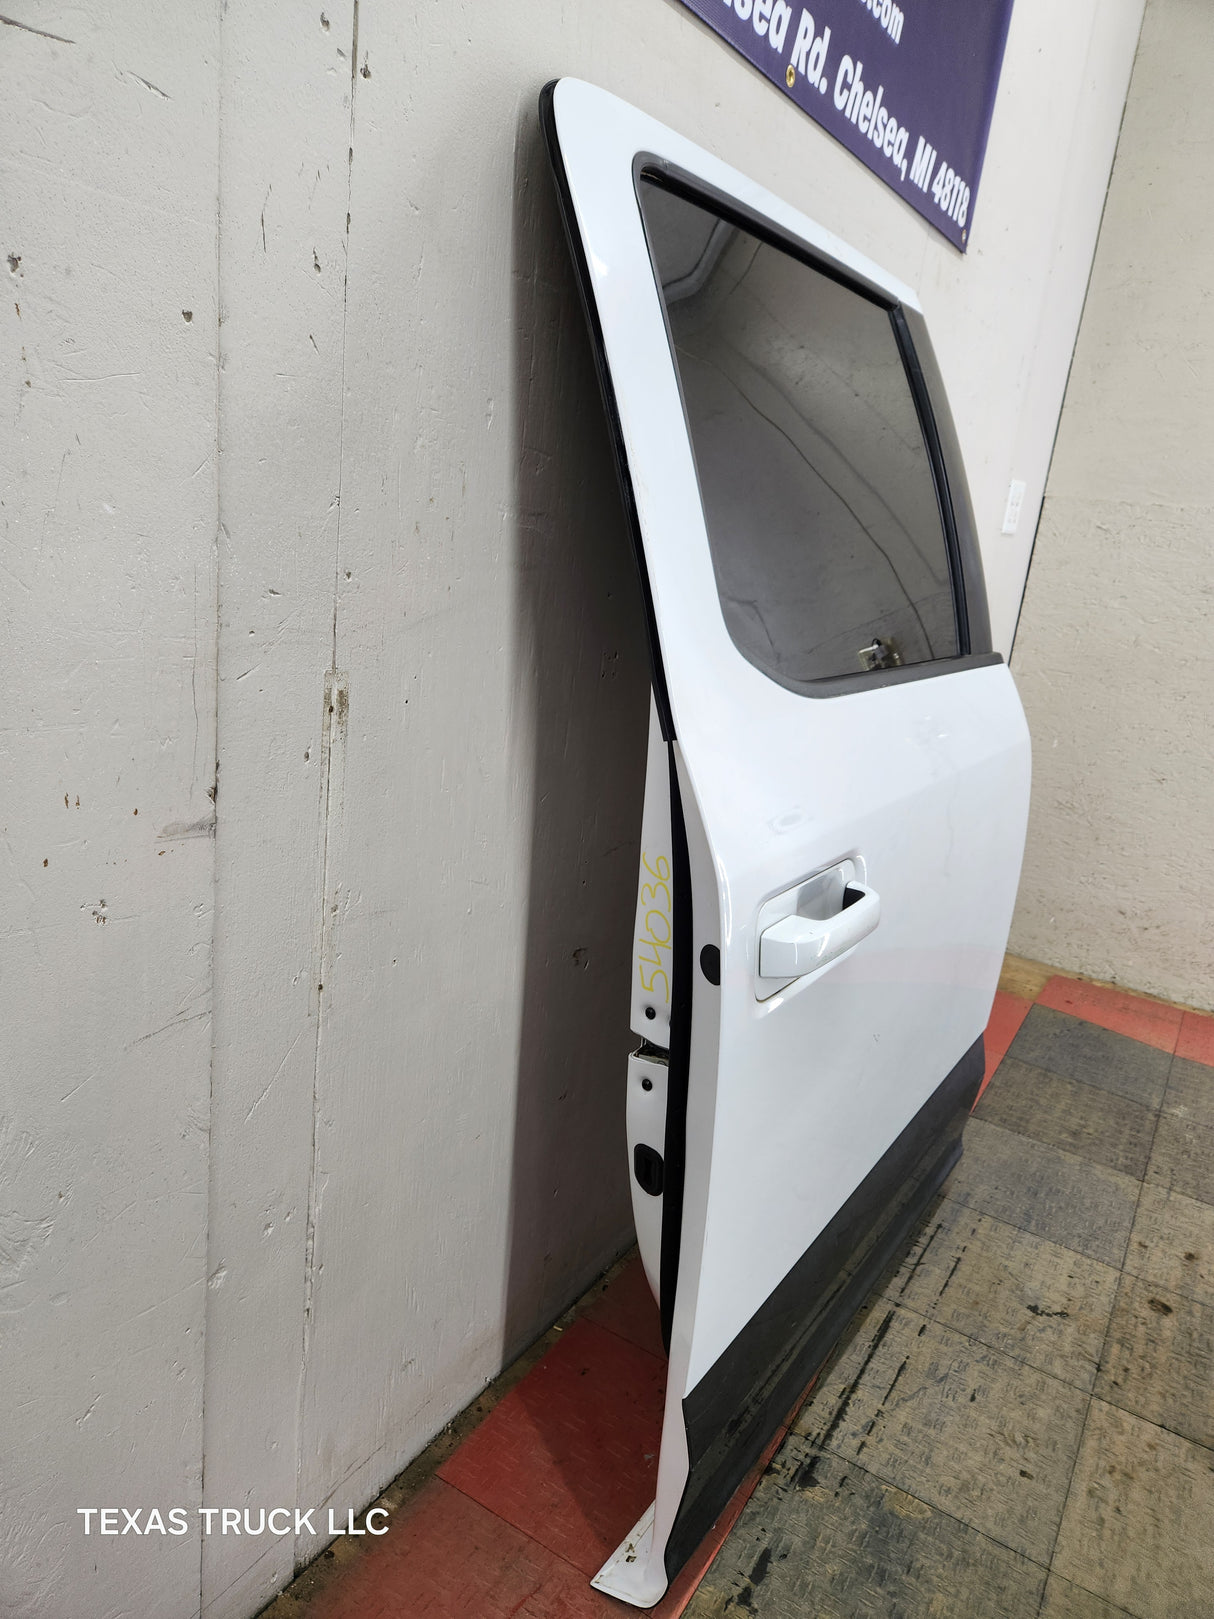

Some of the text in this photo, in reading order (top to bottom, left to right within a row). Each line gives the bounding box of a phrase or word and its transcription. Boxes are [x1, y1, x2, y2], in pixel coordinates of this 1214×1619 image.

[790, 8, 831, 94] Rd.
[834, 54, 910, 181] Chelsea,
[909, 136, 937, 193] MI
[931, 161, 971, 228] 48118
[638, 852, 672, 1003] 54036
